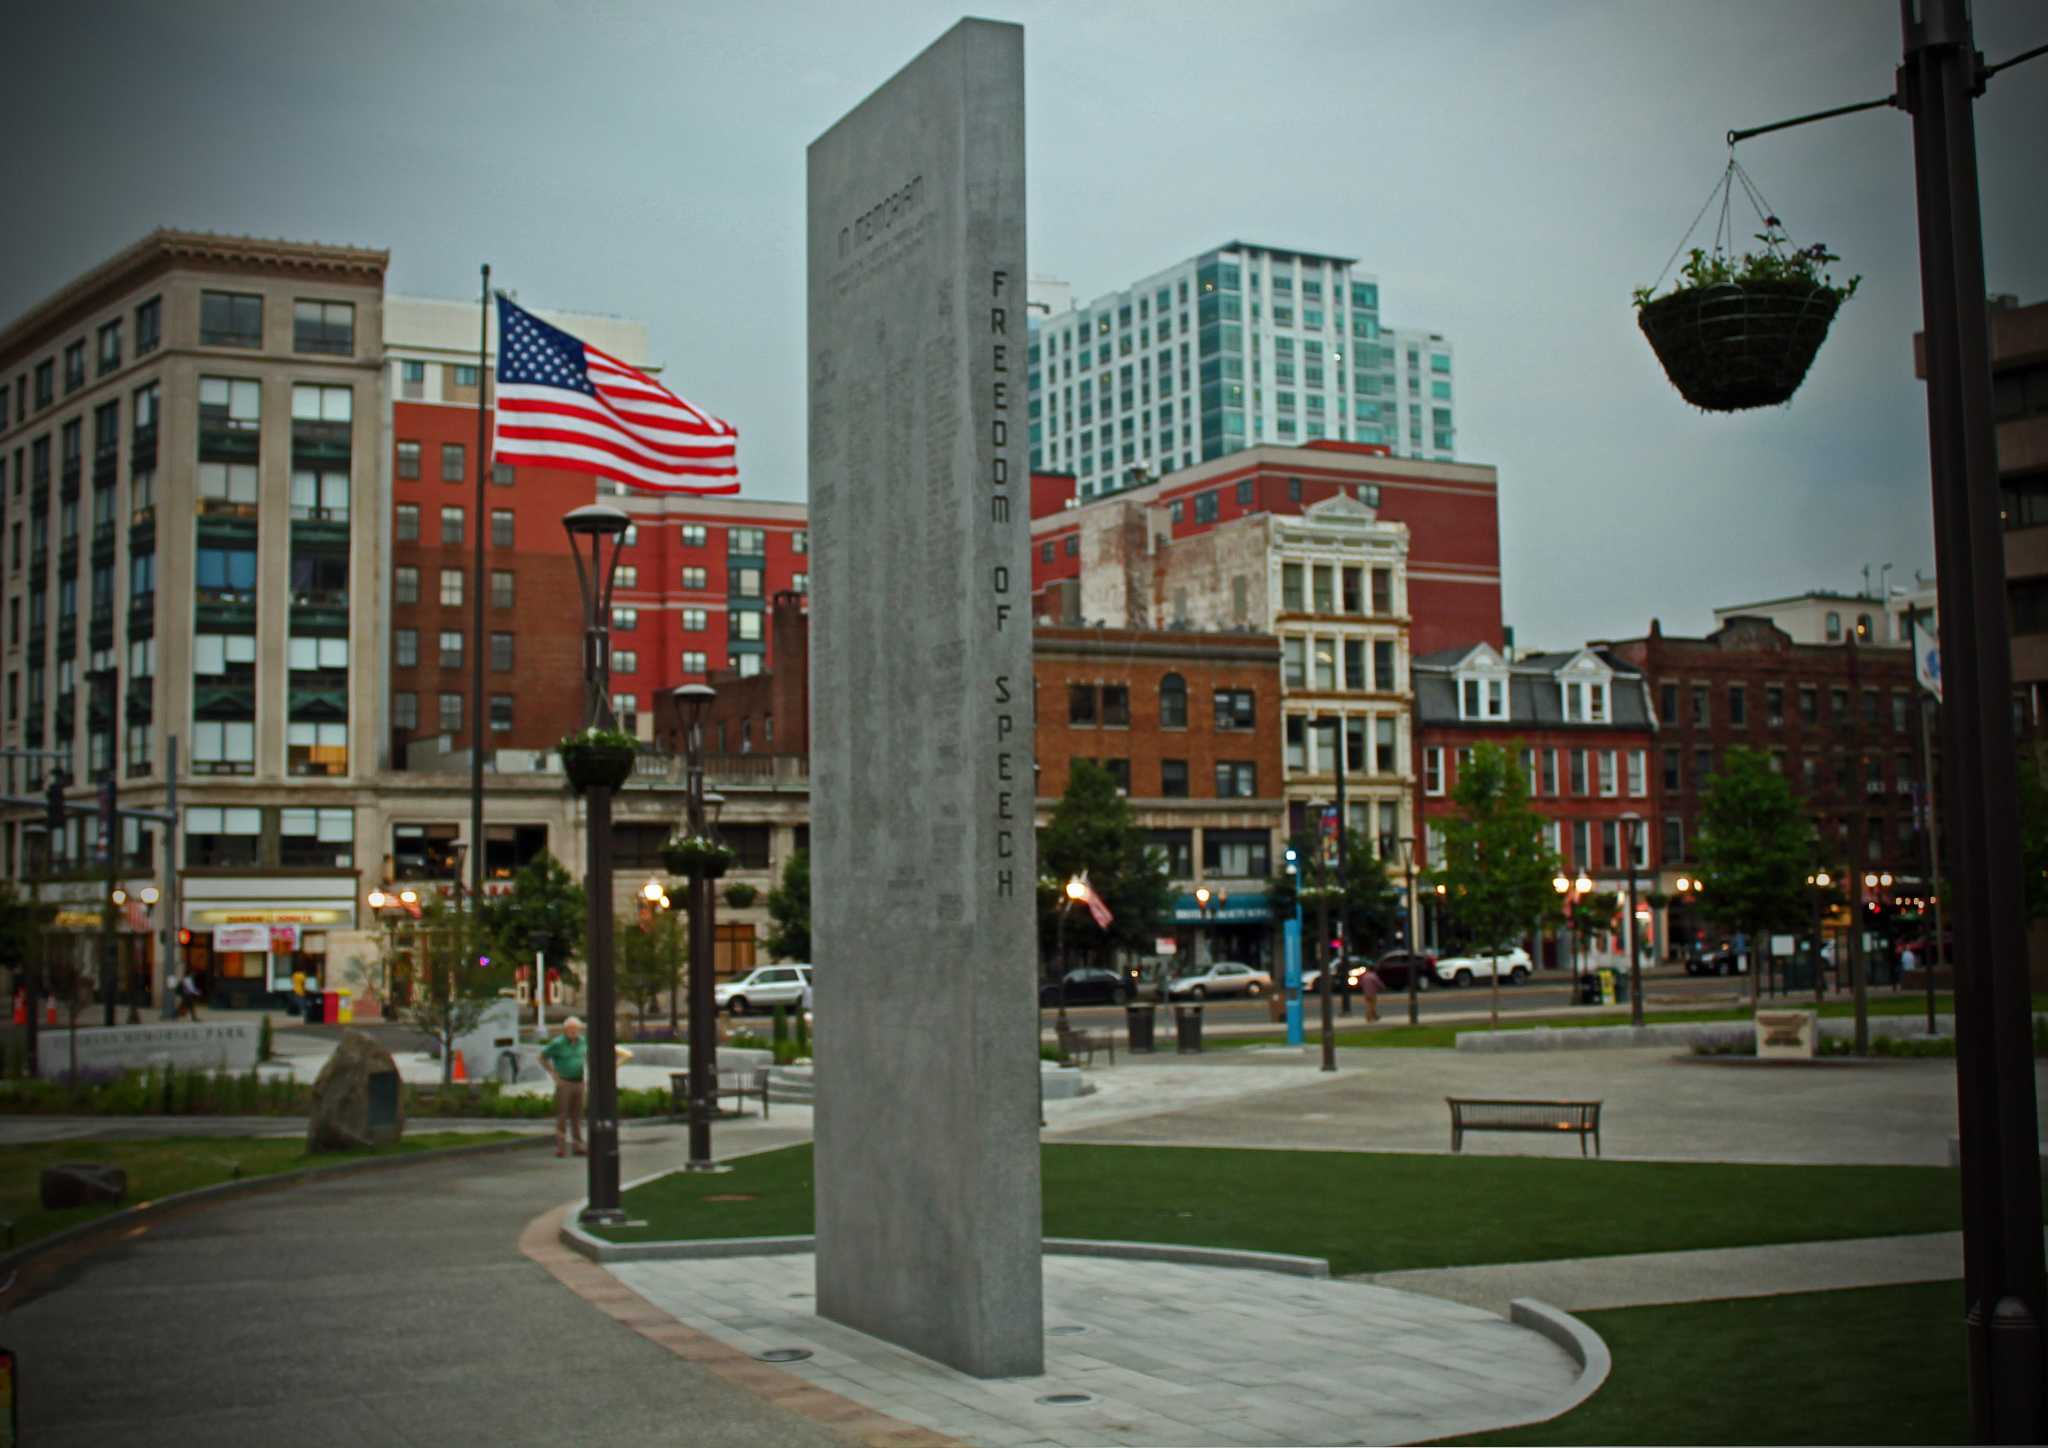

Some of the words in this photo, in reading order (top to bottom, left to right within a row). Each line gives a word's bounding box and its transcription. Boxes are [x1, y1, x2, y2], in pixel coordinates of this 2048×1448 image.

[991, 271, 1009, 523] FREEDOM
[995, 567, 1011, 632] OF
[995, 676, 1013, 897] SPEECH
[205, 1026, 246, 1040] PARK
